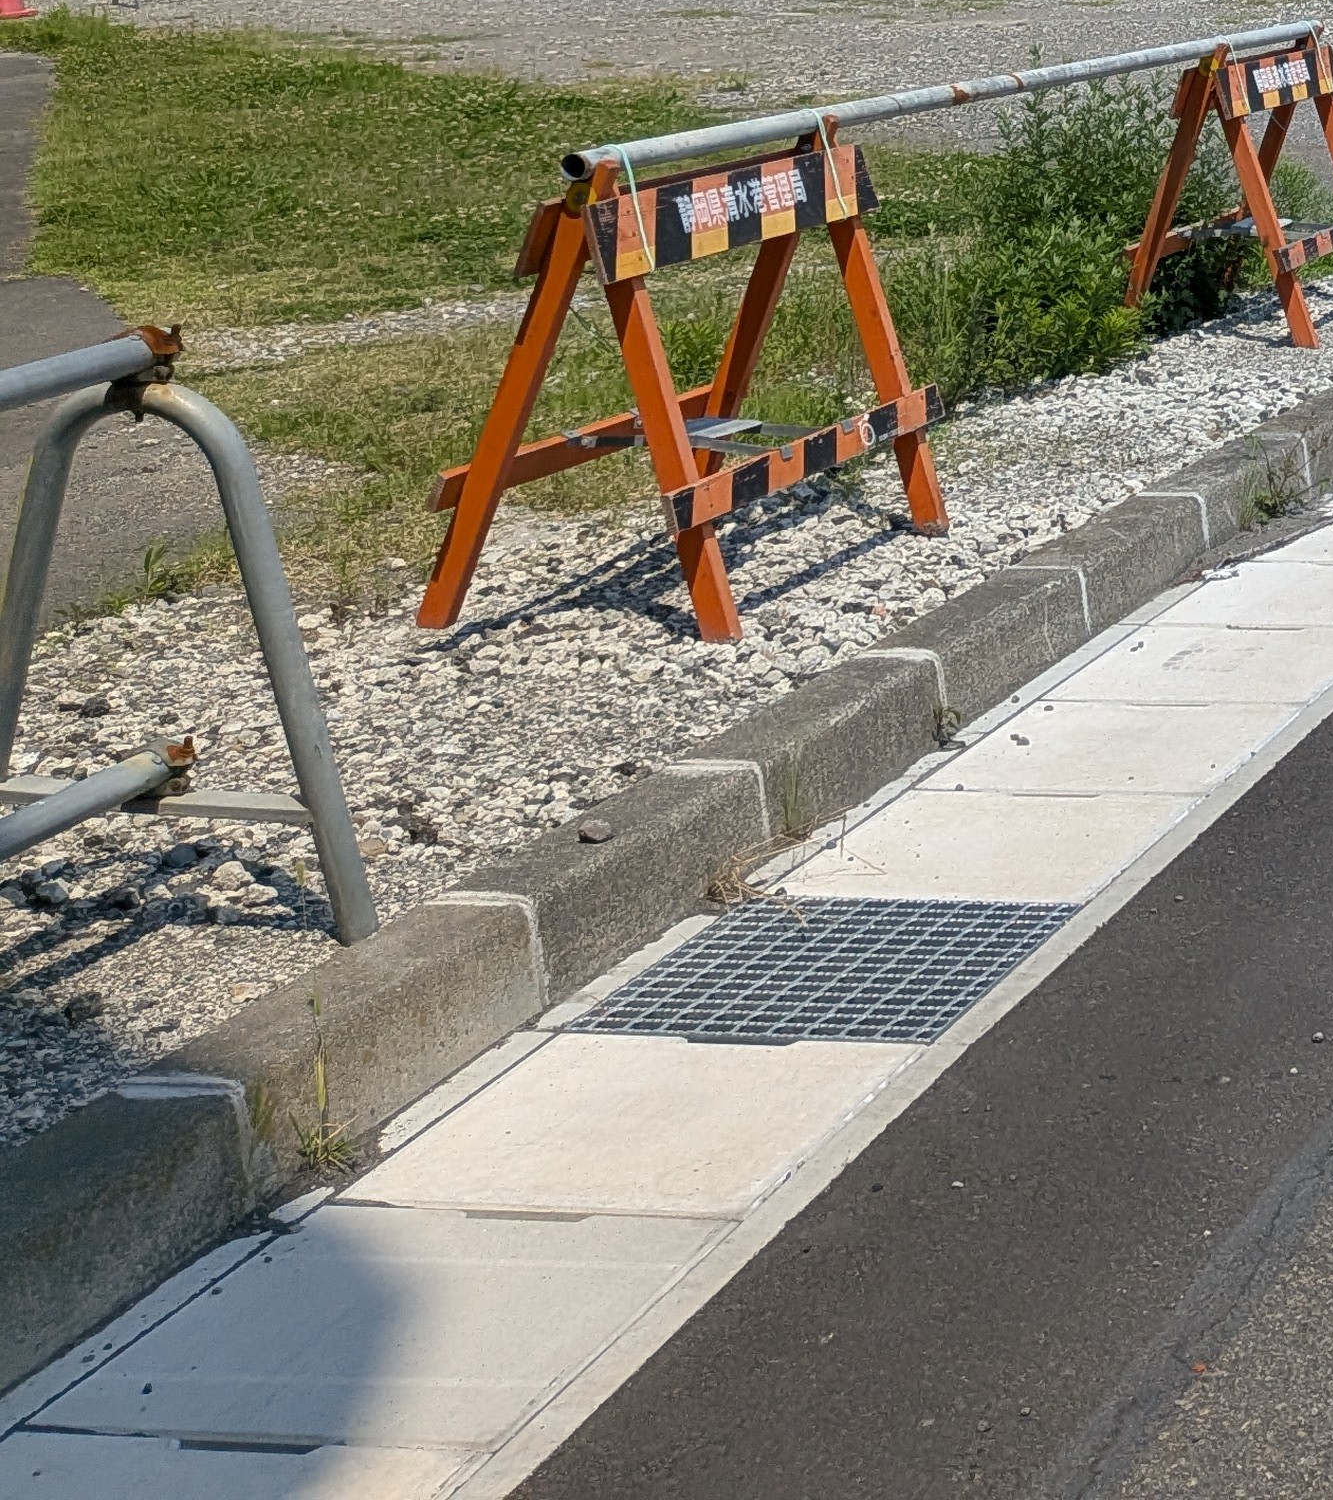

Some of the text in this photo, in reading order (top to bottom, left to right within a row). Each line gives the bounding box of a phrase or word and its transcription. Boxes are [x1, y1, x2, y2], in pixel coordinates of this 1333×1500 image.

[673, 168, 808, 234] 静岡県清水港管理局
